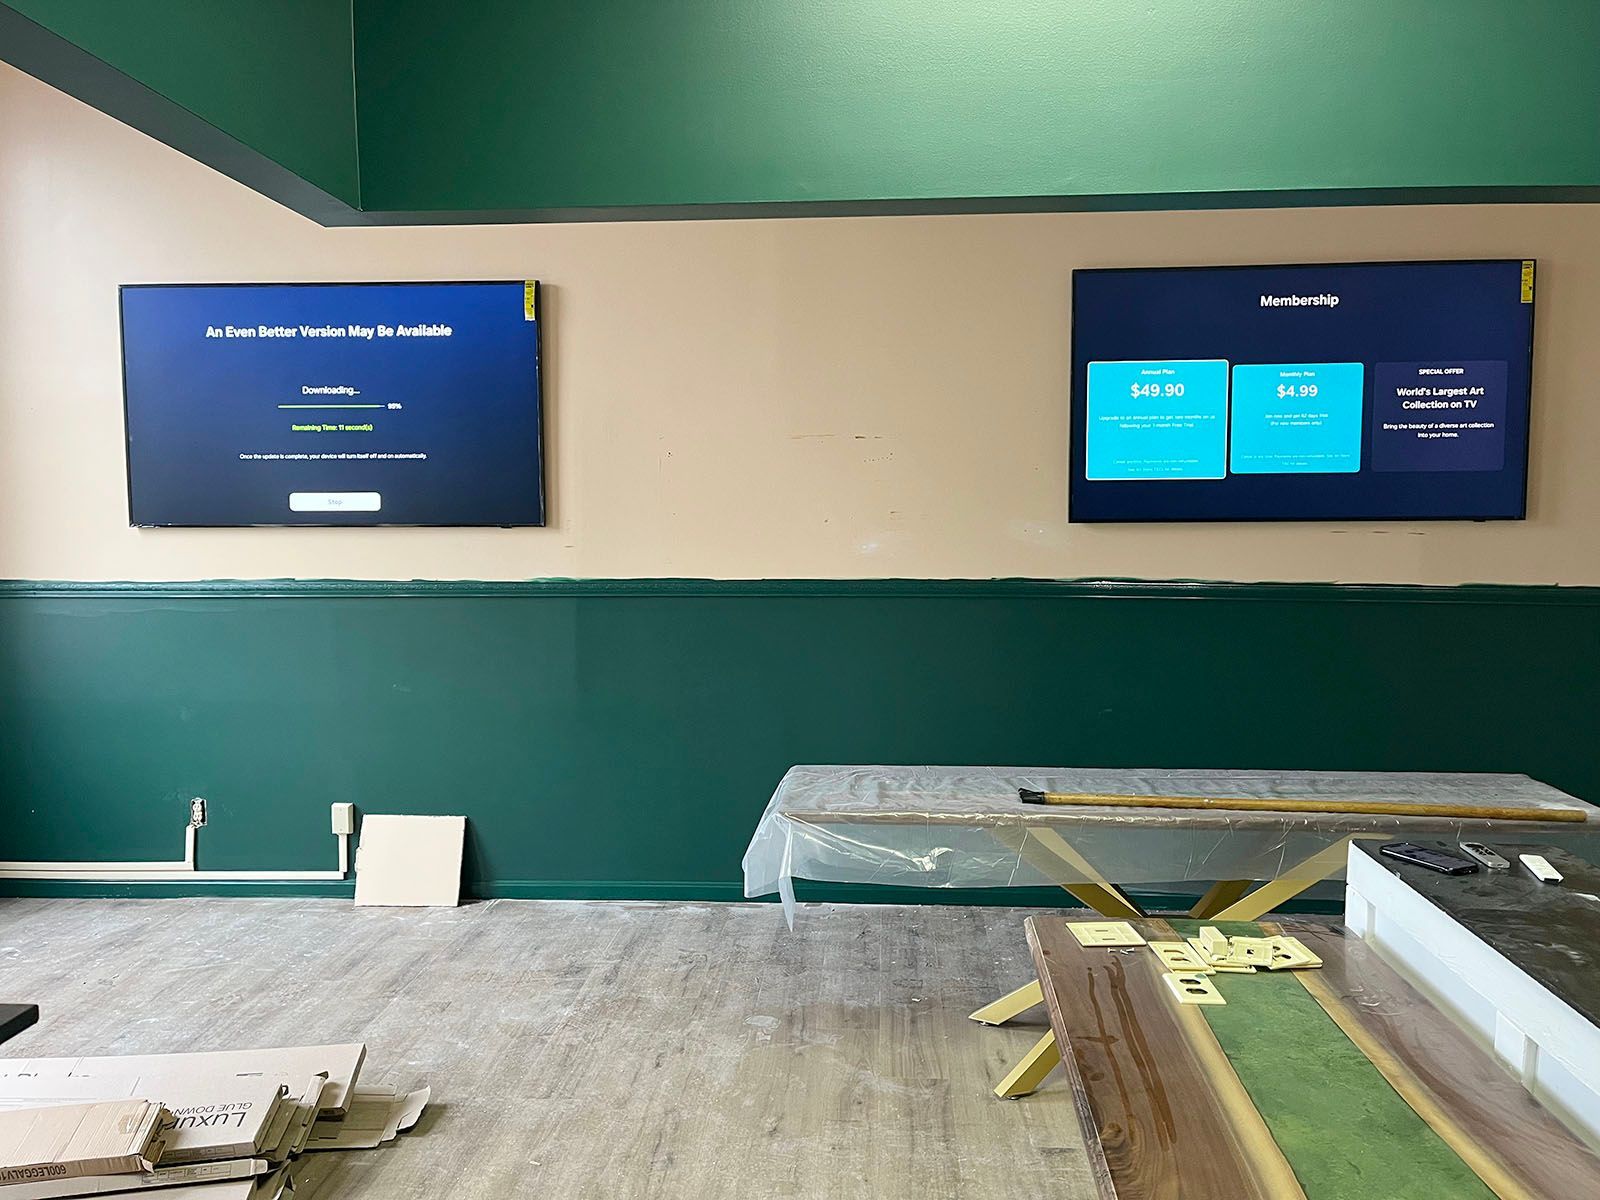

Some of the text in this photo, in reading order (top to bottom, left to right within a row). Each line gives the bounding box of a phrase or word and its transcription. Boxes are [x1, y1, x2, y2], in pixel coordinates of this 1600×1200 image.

[1260, 294, 1340, 308] Membership
[206, 323, 453, 340] An Even Better Version May Be Available
[301, 385, 361, 396] Downloading...
[1130, 382, 1185, 399] $49.90
[1276, 383, 1319, 399] $4.99
[1396, 386, 1485, 397] World's Largest Art
[1402, 400, 1478, 410] Collection on TV
[291, 424, 321, 432] Remaining
[174, 1102, 252, 1116] GLUE DOWN
[0, 1164, 67, 1181] 600LEGGALV1
